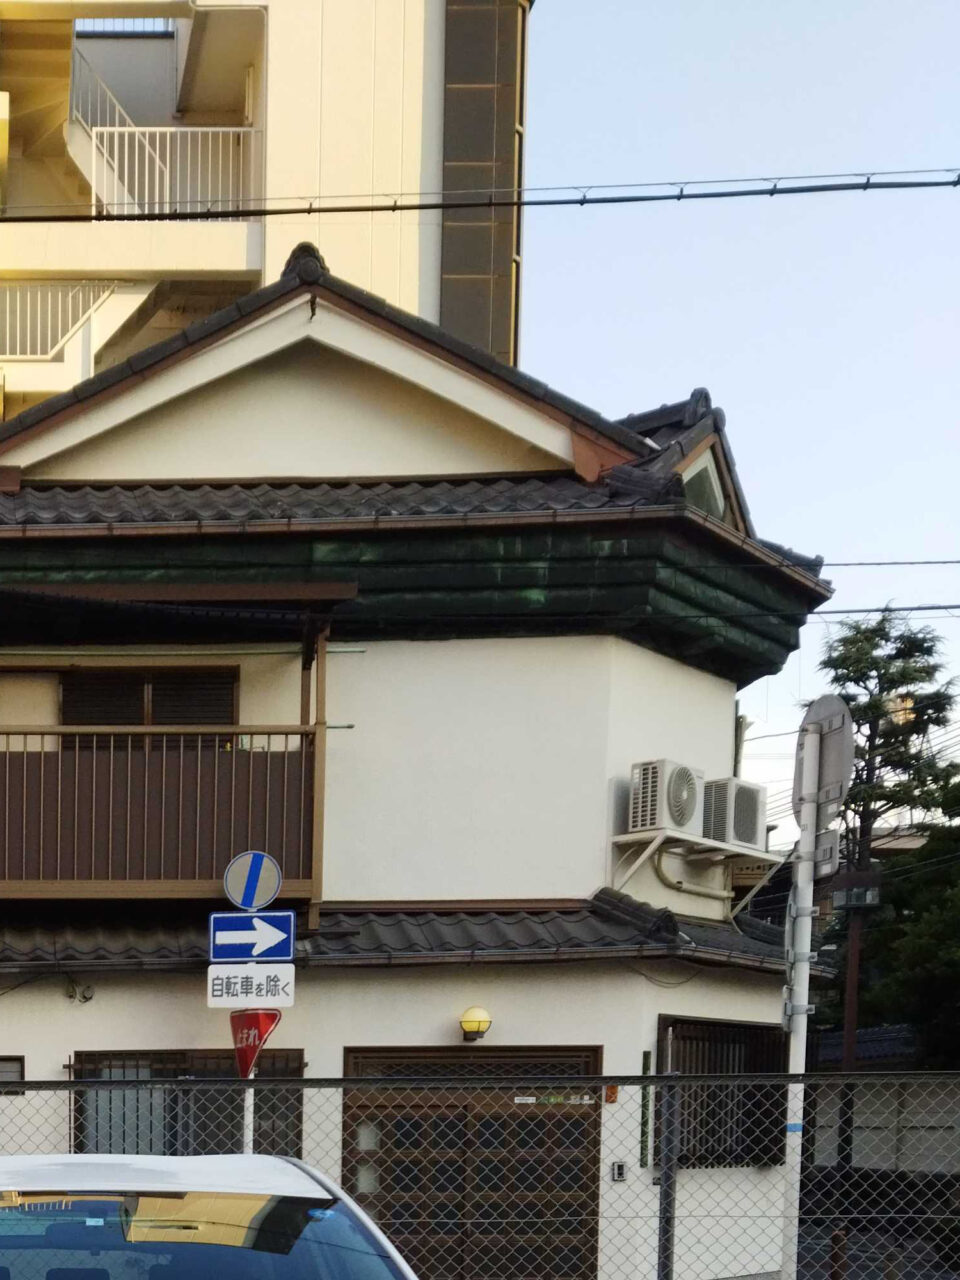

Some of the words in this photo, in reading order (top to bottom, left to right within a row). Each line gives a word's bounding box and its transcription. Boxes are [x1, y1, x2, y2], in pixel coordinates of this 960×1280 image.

[212, 975, 290, 998] 自転車を除く
